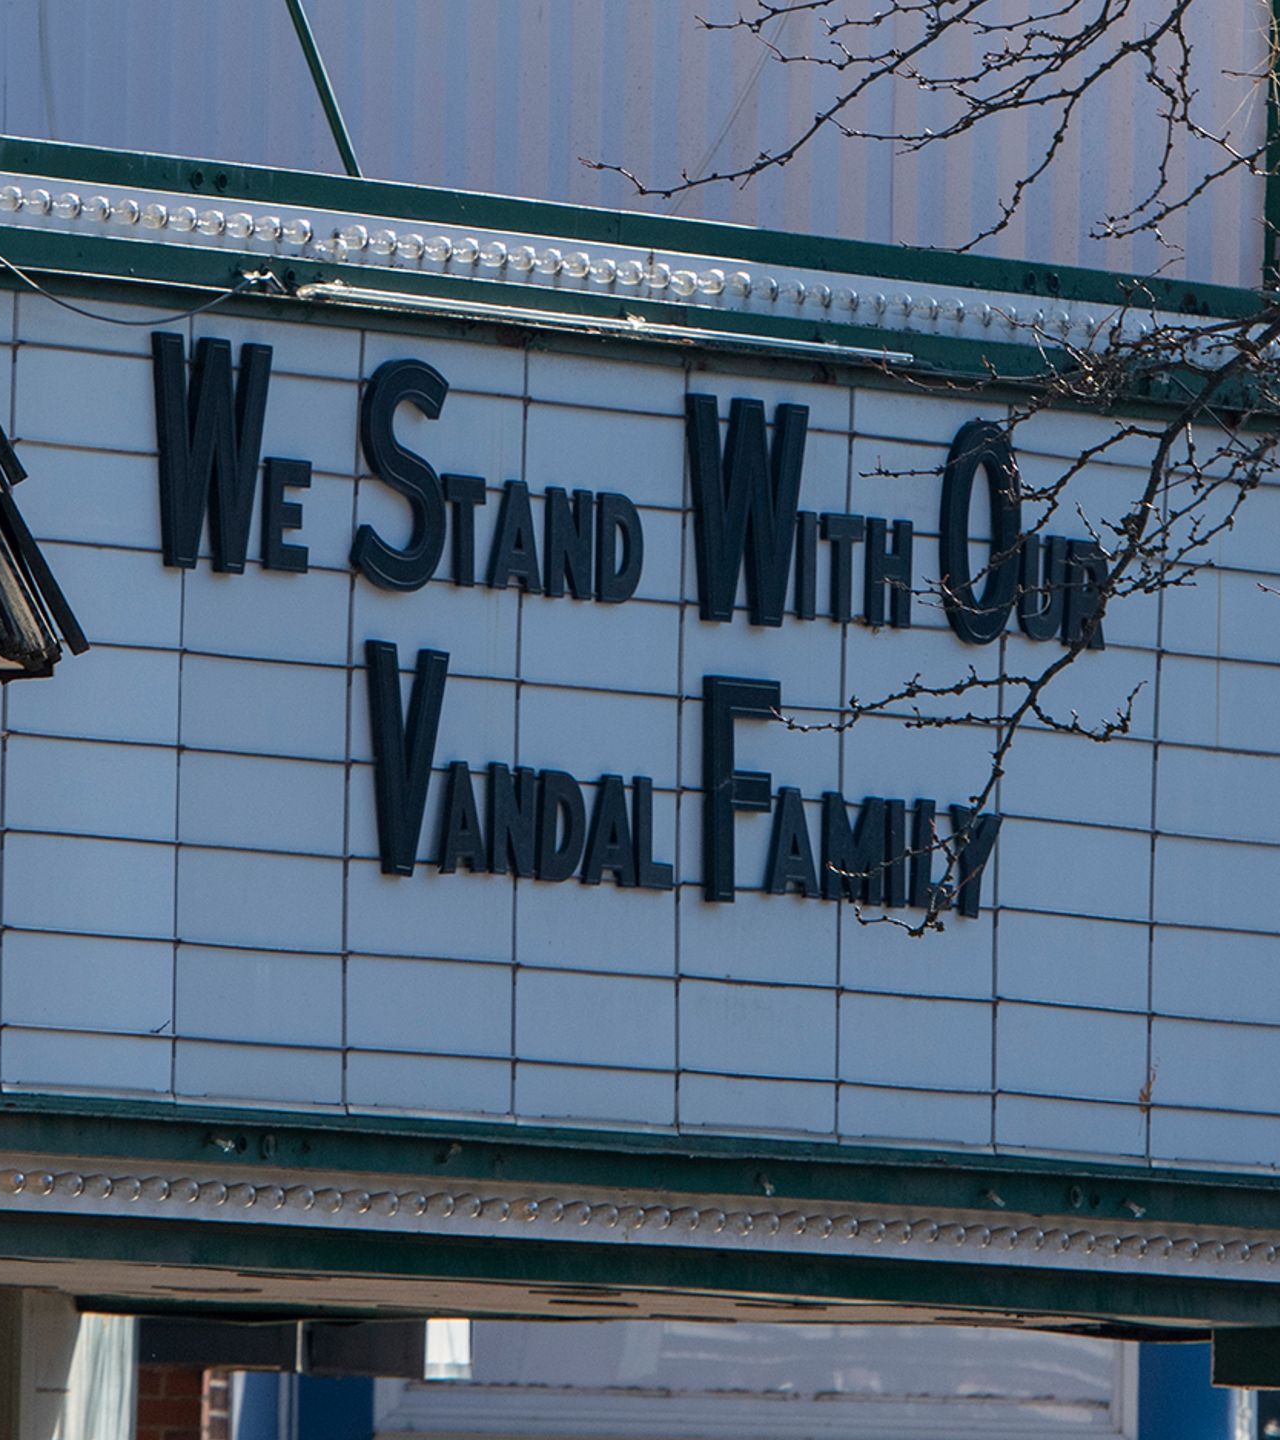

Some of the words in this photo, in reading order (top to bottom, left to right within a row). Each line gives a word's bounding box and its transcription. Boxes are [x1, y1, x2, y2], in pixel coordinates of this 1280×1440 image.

[151, 330, 313, 575] WE
[350, 357, 645, 605] STAND
[686, 392, 914, 629] WITH
[939, 420, 1110, 651] OUR
[365, 638, 674, 892] VANDAL
[702, 673, 1004, 920] FAMILY
